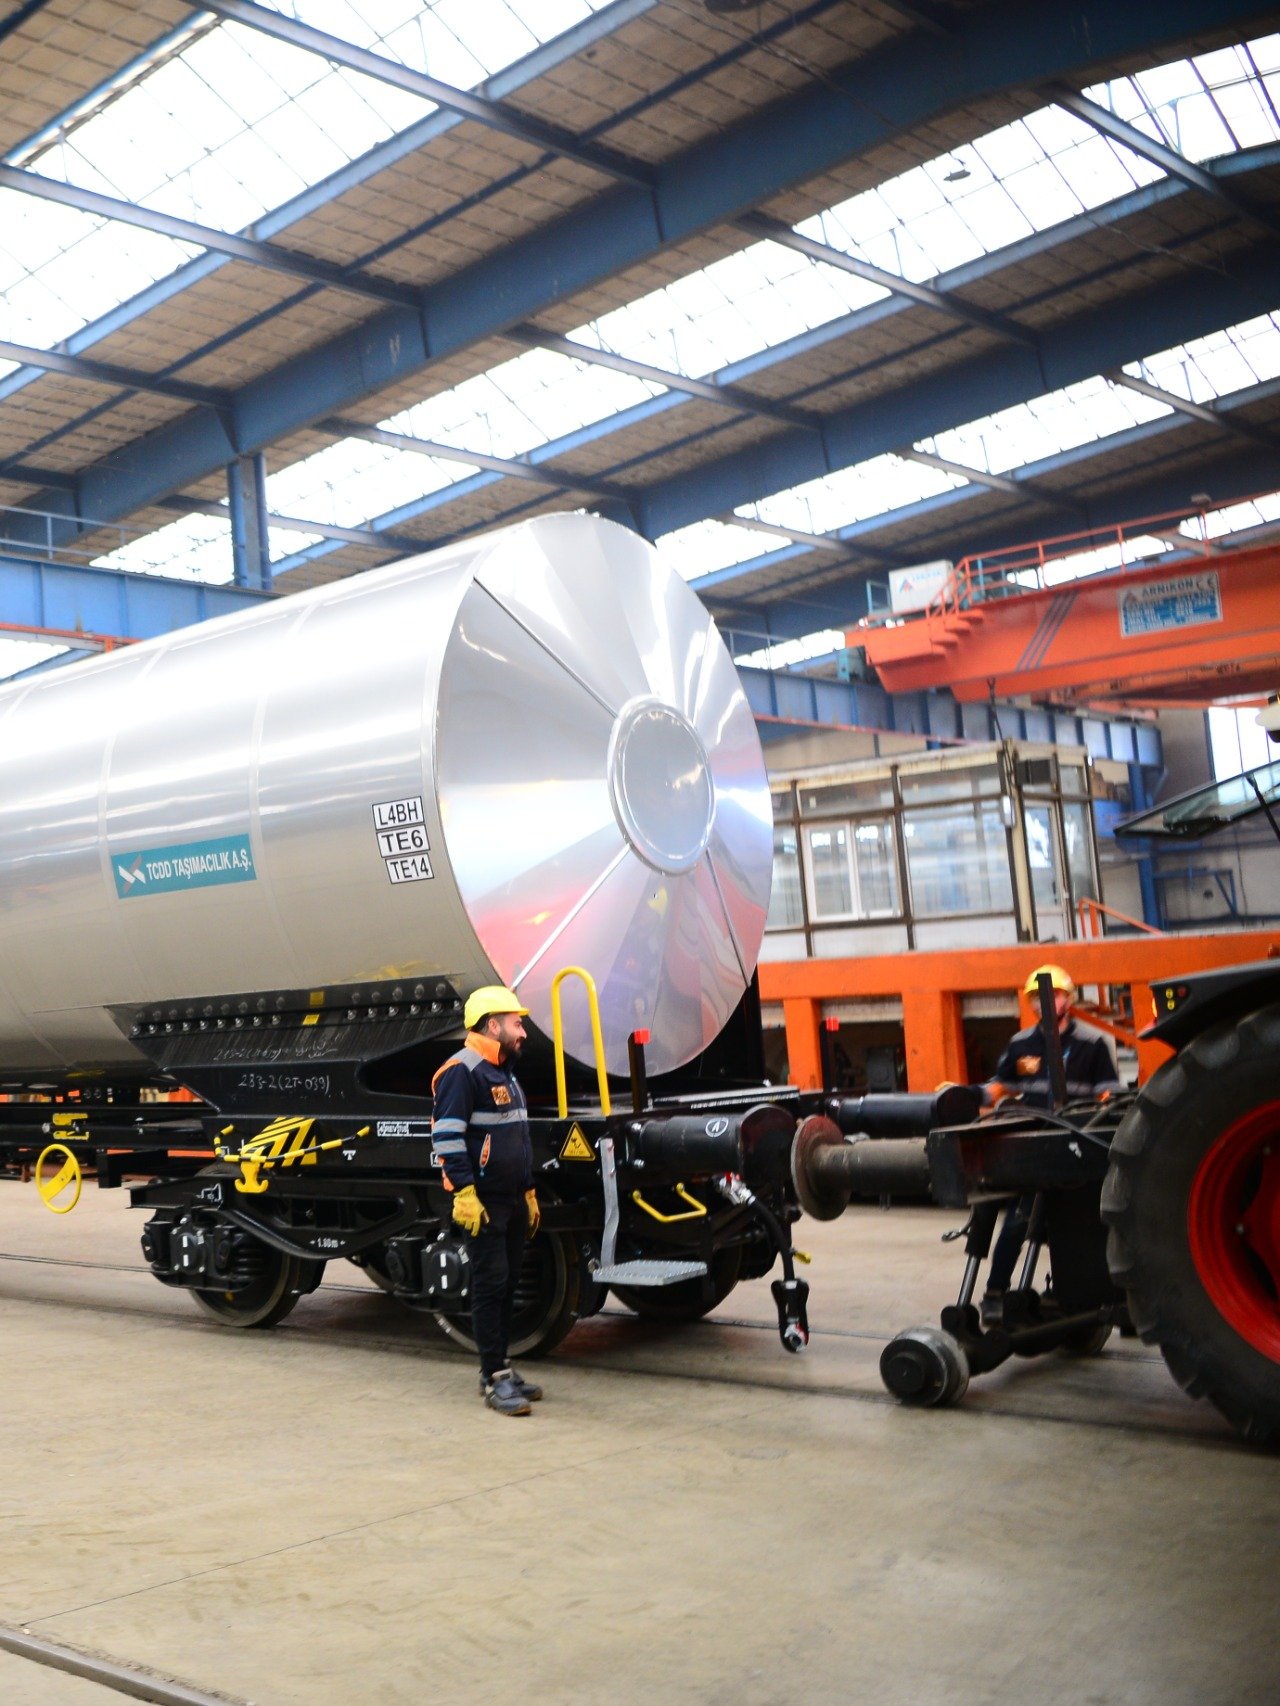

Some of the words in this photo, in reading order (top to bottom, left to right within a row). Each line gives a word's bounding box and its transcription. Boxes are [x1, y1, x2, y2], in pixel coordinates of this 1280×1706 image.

[378, 801, 418, 826] L4BH
[381, 829, 423, 853] TE6
[146, 860, 172, 881] TCDD
[172, 851, 232, 880] TAŞIMACILIK
[390, 856, 429, 880] TE14
